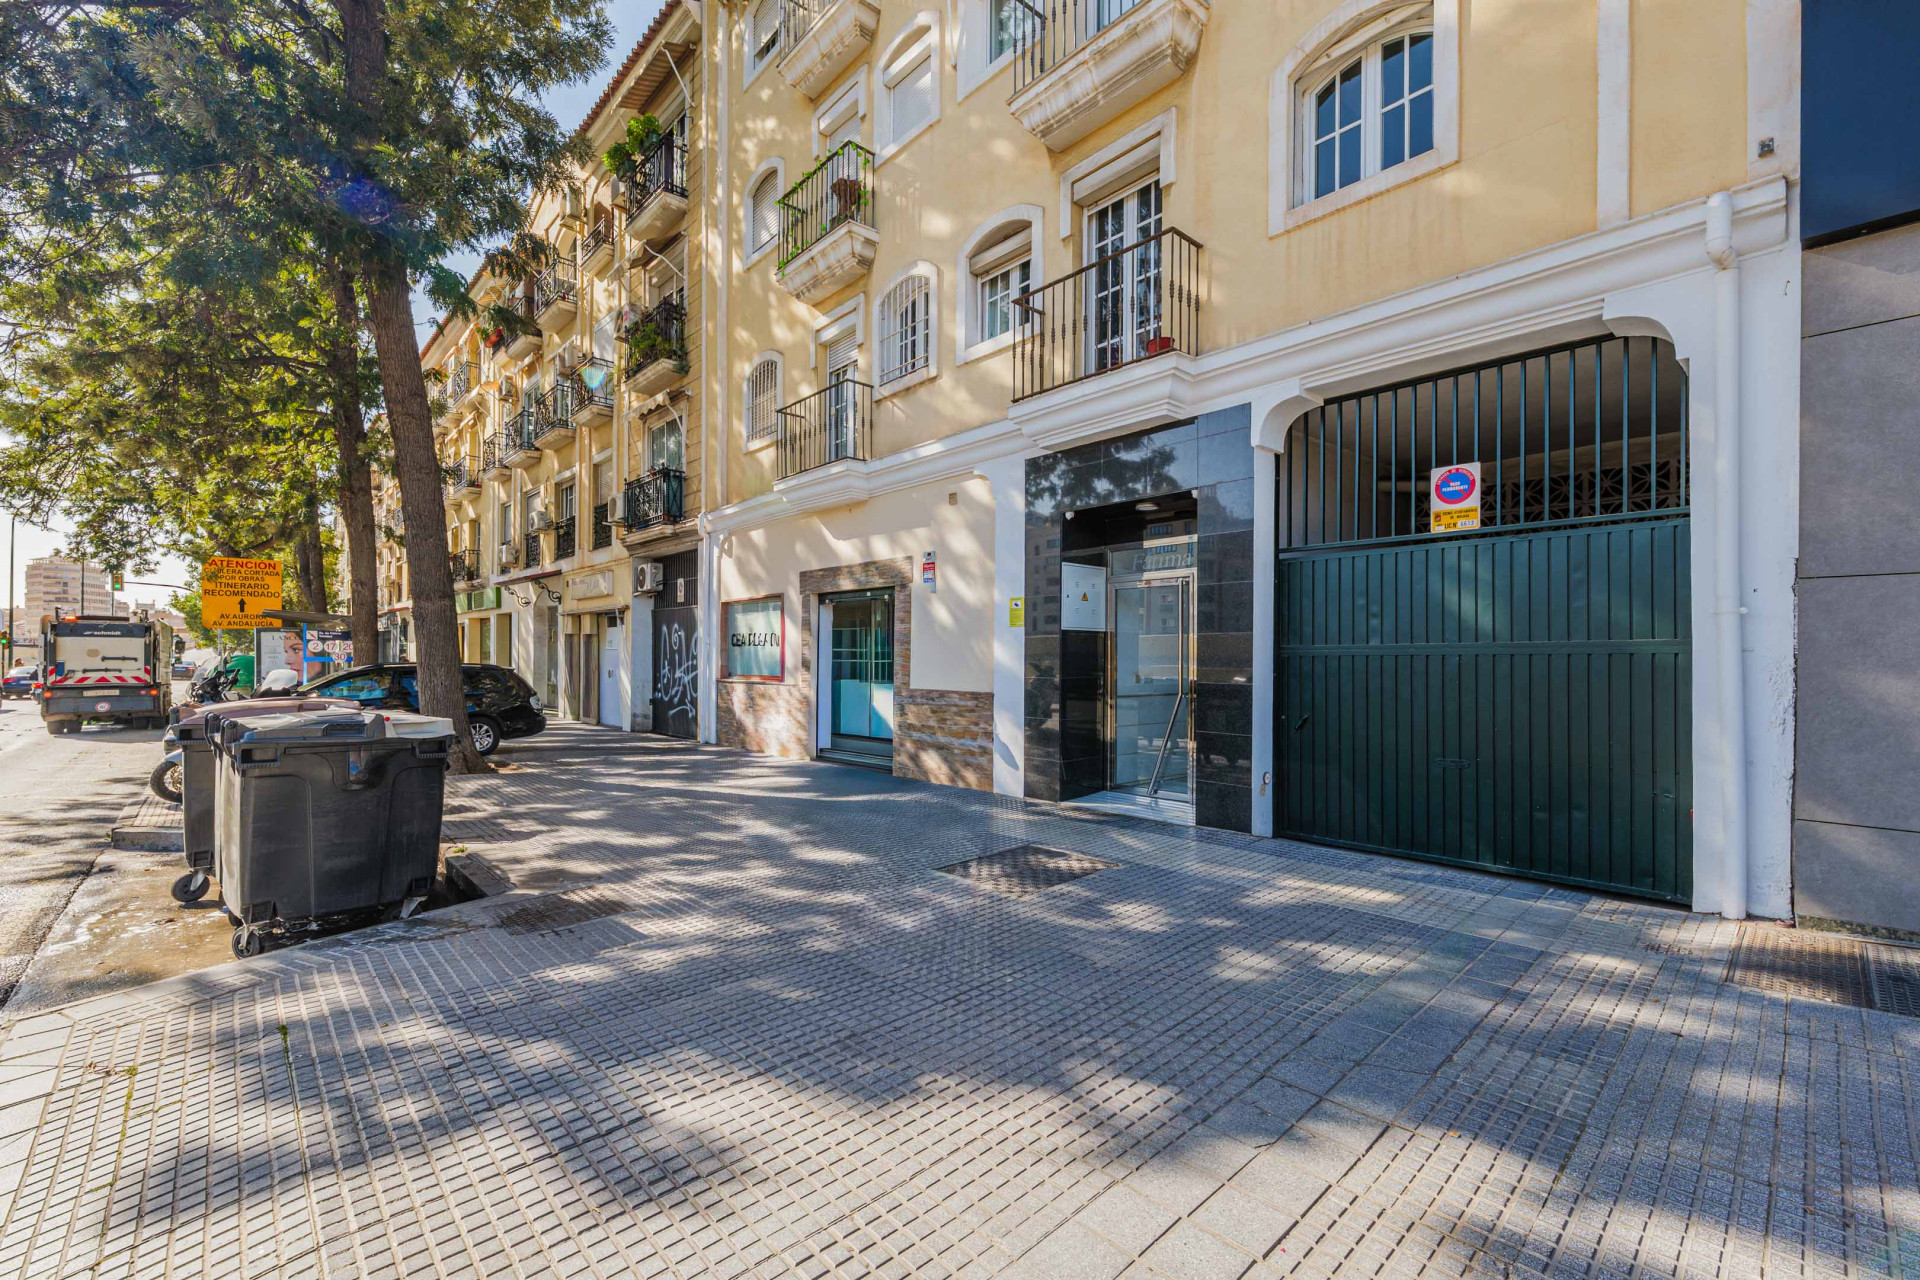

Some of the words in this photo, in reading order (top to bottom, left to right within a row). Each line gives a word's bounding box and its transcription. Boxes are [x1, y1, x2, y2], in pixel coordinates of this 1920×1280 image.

[210, 559, 276, 570] ATENCIÓN
[215, 582, 270, 590] ITINERARIO
[204, 589, 280, 598] RECOMENDADO
[227, 619, 274, 627] ANDALUCÍA
[312, 642, 319, 650] 2
[325, 642, 336, 650] 17
[334, 653, 346, 661] 30
